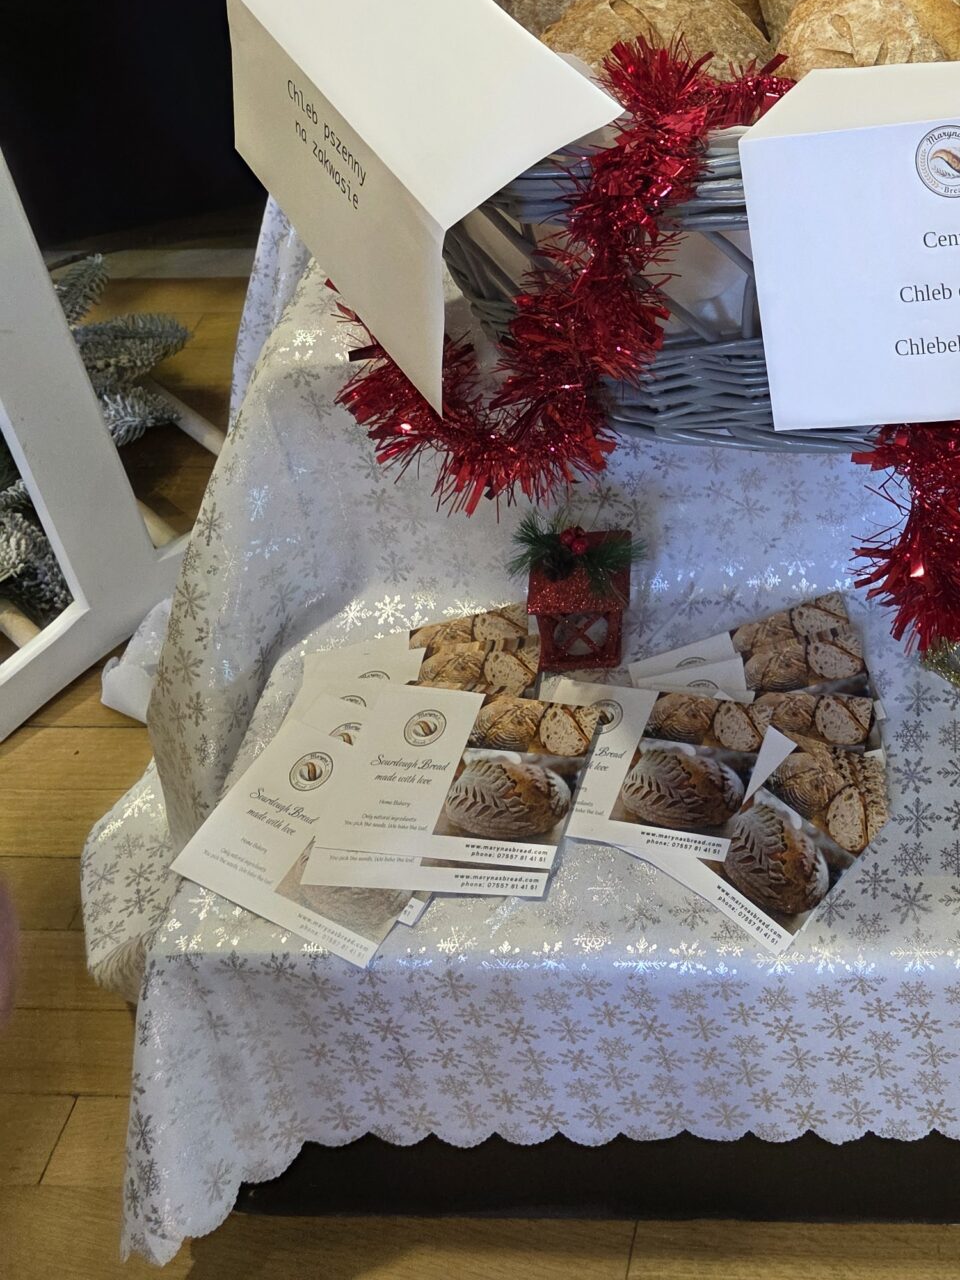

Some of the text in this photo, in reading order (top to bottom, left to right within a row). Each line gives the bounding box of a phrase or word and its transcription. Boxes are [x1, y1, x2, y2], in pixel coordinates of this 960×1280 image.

[287, 79, 367, 187] Chleb pszenny
[295, 120, 359, 211] na zakwasie
[899, 282, 953, 304] Chleb
